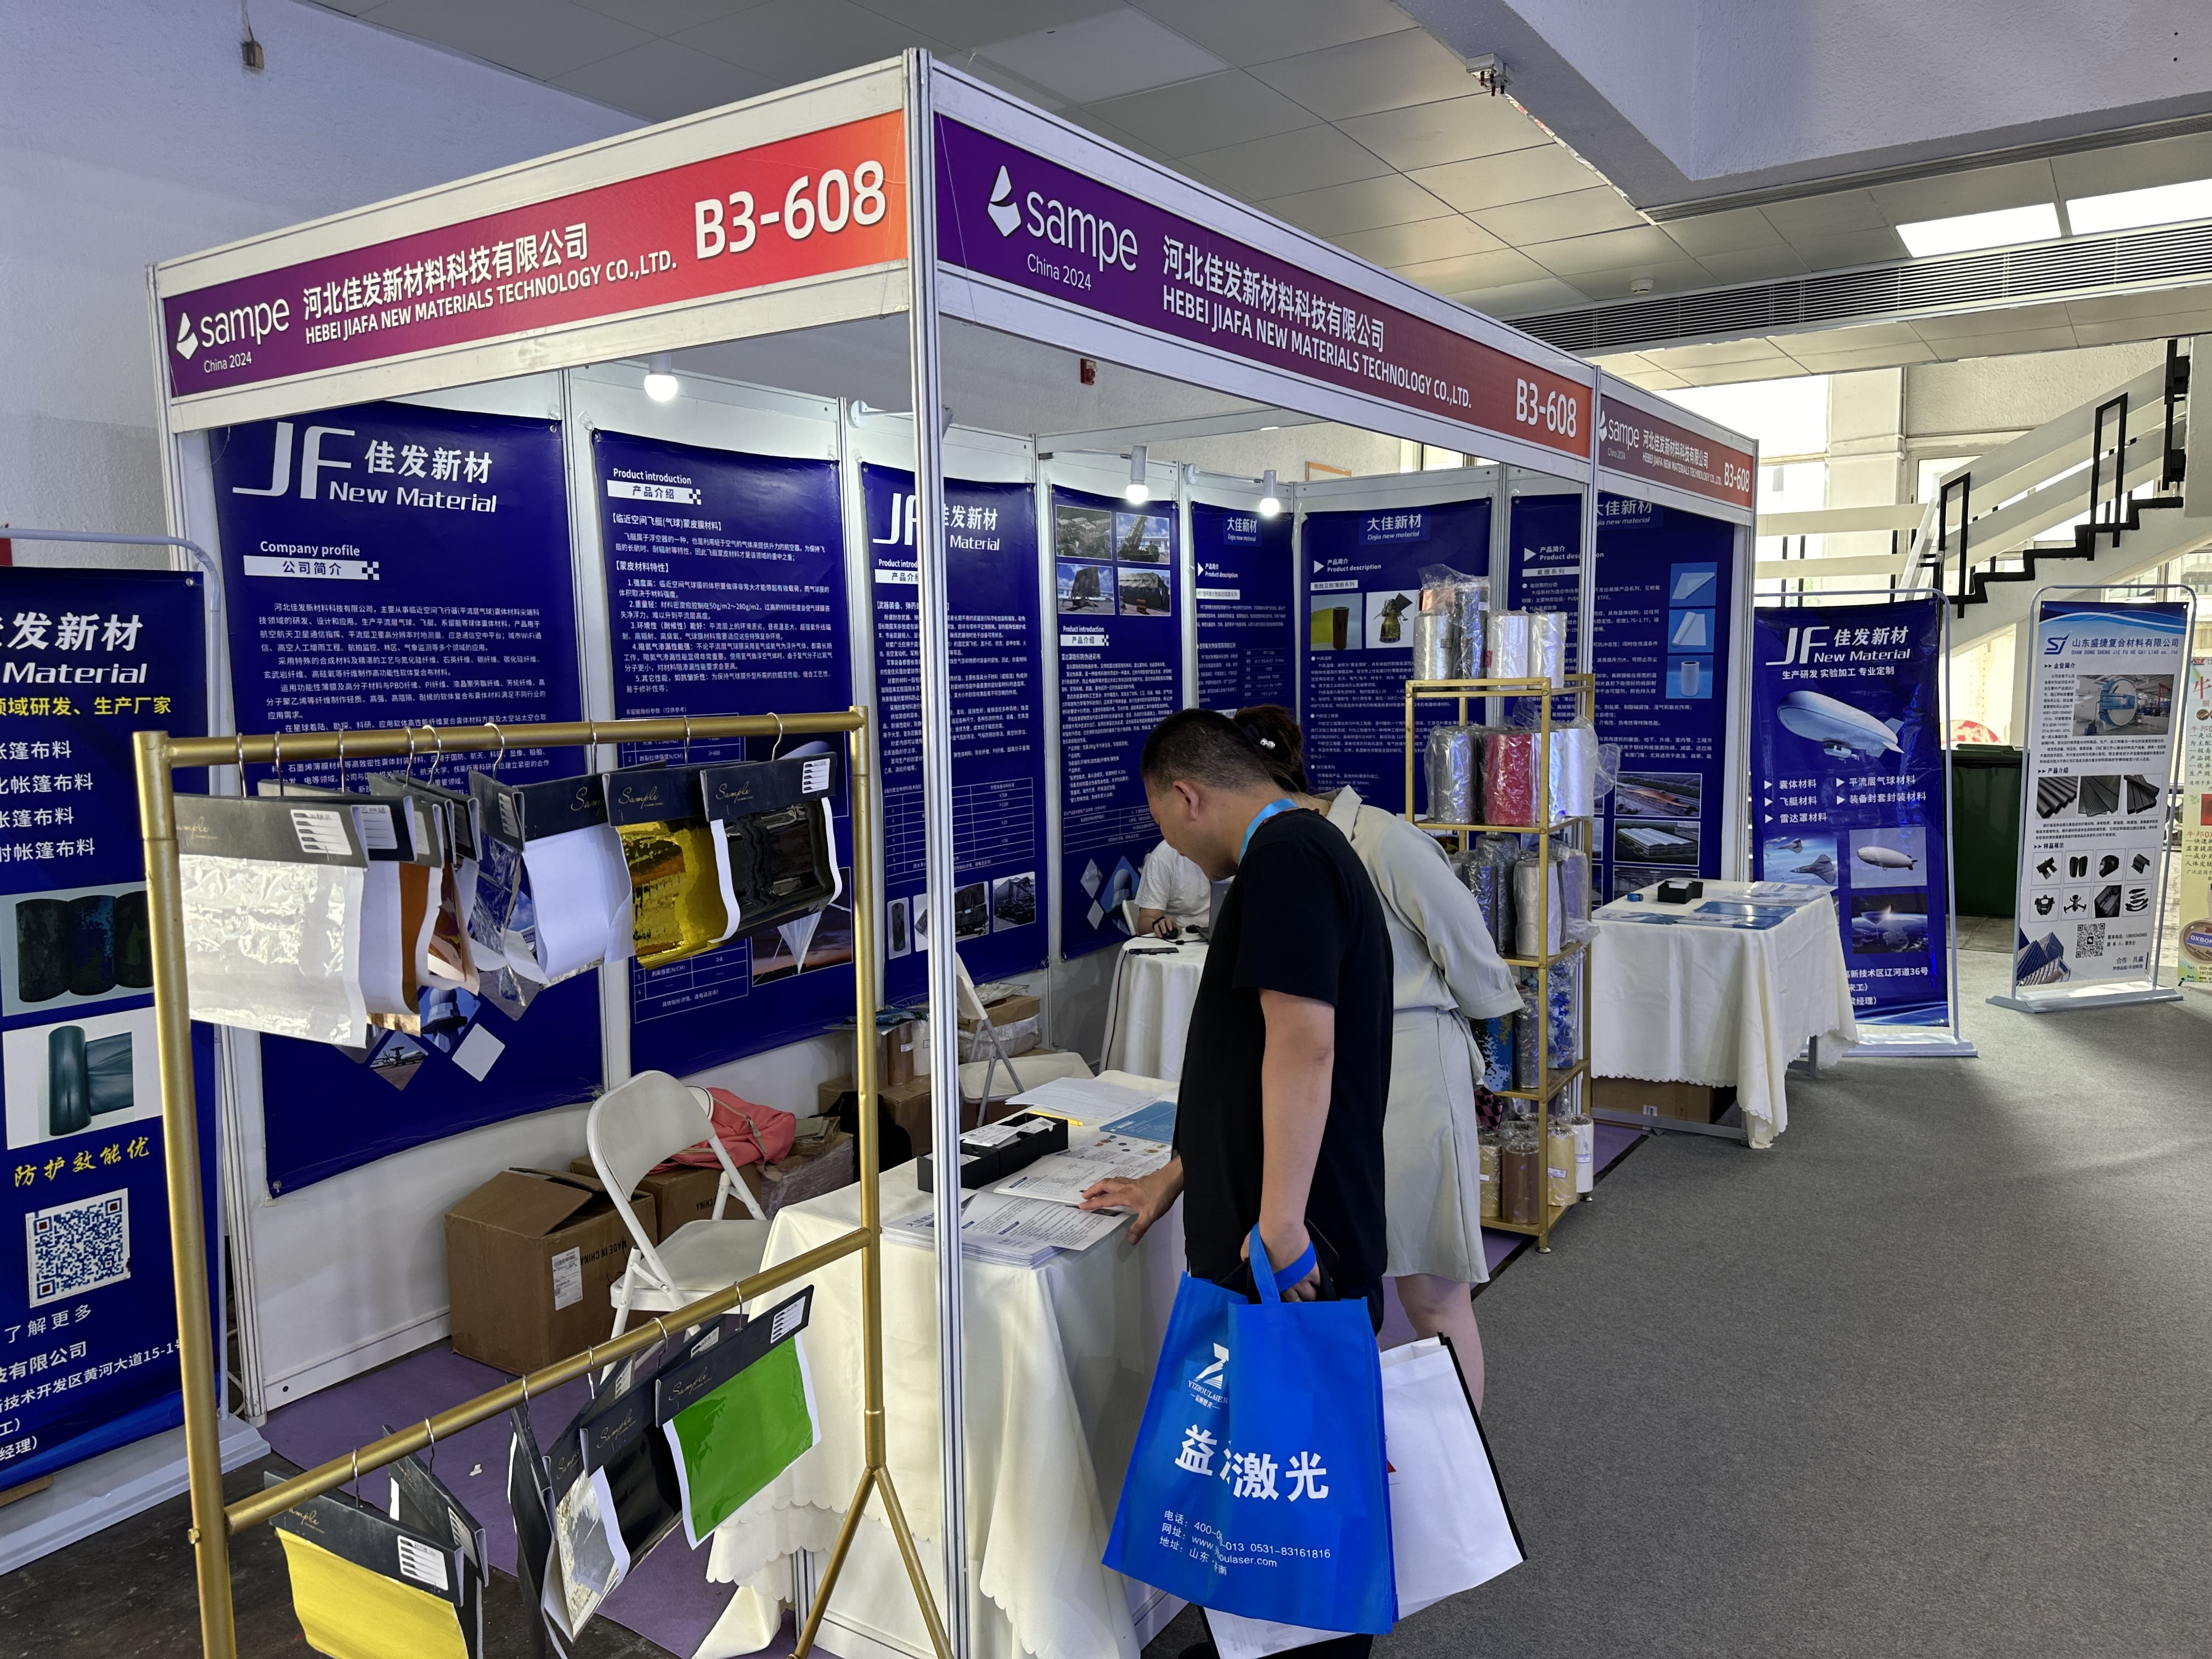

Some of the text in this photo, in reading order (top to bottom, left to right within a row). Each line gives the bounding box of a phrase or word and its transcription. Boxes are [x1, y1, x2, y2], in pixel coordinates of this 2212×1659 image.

[695, 160, 887, 260] B3-608
[1026, 190, 1139, 272] sampe
[303, 222, 588, 320] 河北佳发新材料科技有限公司
[1028, 253, 1092, 292] China 2024
[306, 321, 341, 345] HEBEI
[343, 314, 379, 342] JIAFA
[381, 306, 411, 329] NEW
[415, 286, 494, 322] MATERIALS
[497, 264, 601, 305] TECHNOLOGY
[1163, 234, 1385, 353] 河北佳发新材料科技有限公司
[200, 298, 290, 348] sampe
[1163, 286, 1209, 324] HEBEI
[1211, 298, 1252, 340] JIAFA
[1255, 317, 1288, 349] NEW
[1291, 328, 1359, 374] MATERIALS
[1362, 355, 1431, 395] TECHNOLOGY
[204, 352, 252, 374] China 2024
[1516, 378, 1577, 438] B3-608
[1608, 419, 1639, 450] sampe
[232, 421, 355, 499] JF
[1607, 447, 1626, 461] China 2024
[1643, 429, 1708, 469] 河北佳发新材料科技有限公司
[365, 439, 493, 484] 佳发新材
[1643, 452, 1652, 464] HEBEI
[1653, 455, 1663, 467] JIAFA
[1663, 459, 1671, 470] NEW
[1672, 461, 1690, 476] MATERIALS
[1690, 467, 1710, 481] TECHNOLOGY
[613, 468, 692, 486] Product introduction
[1724, 462, 1750, 493] B3-608
[329, 481, 496, 513] New Material
[632, 485, 674, 500] 产品介绍
[1227, 517, 1257, 533] 大佳新材
[1367, 514, 1422, 532] 大佳新材
[1606, 516, 1650, 526] new material
[260, 540, 360, 557] Company profile
[950, 535, 1000, 551] Material
[283, 560, 342, 576] 公司简介
[879, 558, 900, 568] Product
[1350, 563, 1381, 572] description
[1540, 552, 1565, 561] Product
[0, 612, 143, 651] 发新材
[1833, 627, 1909, 647] 佳发新材
[2072, 638, 2179, 648] 山东盛捷复合材料有限公司
[1765, 626, 1830, 665] JF
[1814, 648, 1910, 663] New Material
[3, 662, 148, 684] Material
[1782, 666, 1894, 680] 生产研发 实验加工 专业定制
[268, 711, 303, 720] 应用需求。
[715, 781, 751, 804] Sample
[1779, 778, 1817, 789] 囊体材料
[1849, 775, 1916, 787] 平流层气球材料
[618, 786, 658, 809] Sample
[1780, 795, 1817, 806] 飞艇材料
[1849, 792, 1927, 804] 装备封套封装材料
[176, 816, 210, 839] ample
[1780, 812, 1827, 823] 雷达罩材料
[15, 1137, 149, 1187] 防护效能优
[580, 1240, 627, 1265] MADE IN CHINA
[4, 1304, 91, 1344] 了解更多
[0, 1339, 180, 1413] 技术开发区黄河大道15-1
[668, 1366, 709, 1401] Sample
[1188, 1380, 1228, 1403] YIZHOULASER
[597, 1409, 633, 1449] Sample
[1162, 1523, 1186, 1539] 网址：
[1164, 1510, 1330, 1558] 电话： 0531-83161816
[1159, 1536, 1183, 1552] 地址：
